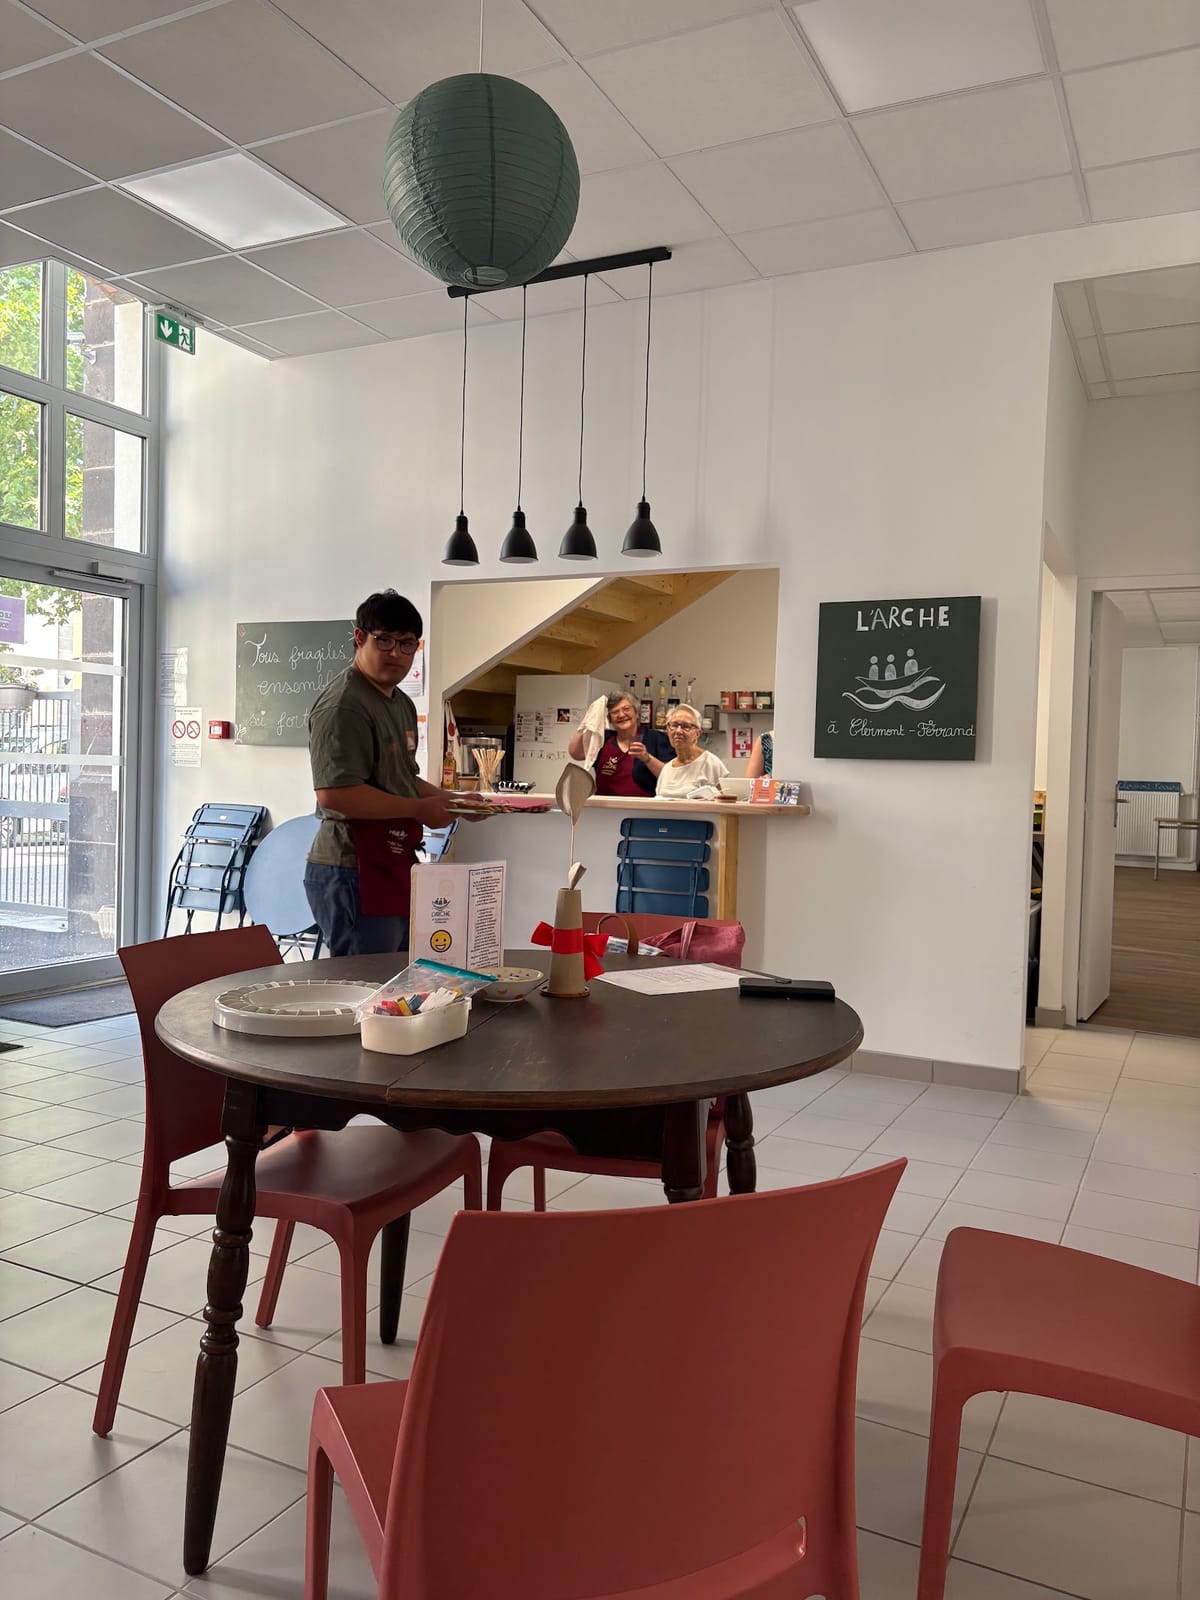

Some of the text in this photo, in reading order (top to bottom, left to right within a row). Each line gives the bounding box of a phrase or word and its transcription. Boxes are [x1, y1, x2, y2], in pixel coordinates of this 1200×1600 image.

[856, 606, 950, 632] L'ARCHE
[244, 633, 280, 667] Tous
[256, 670, 334, 696] ensembl
